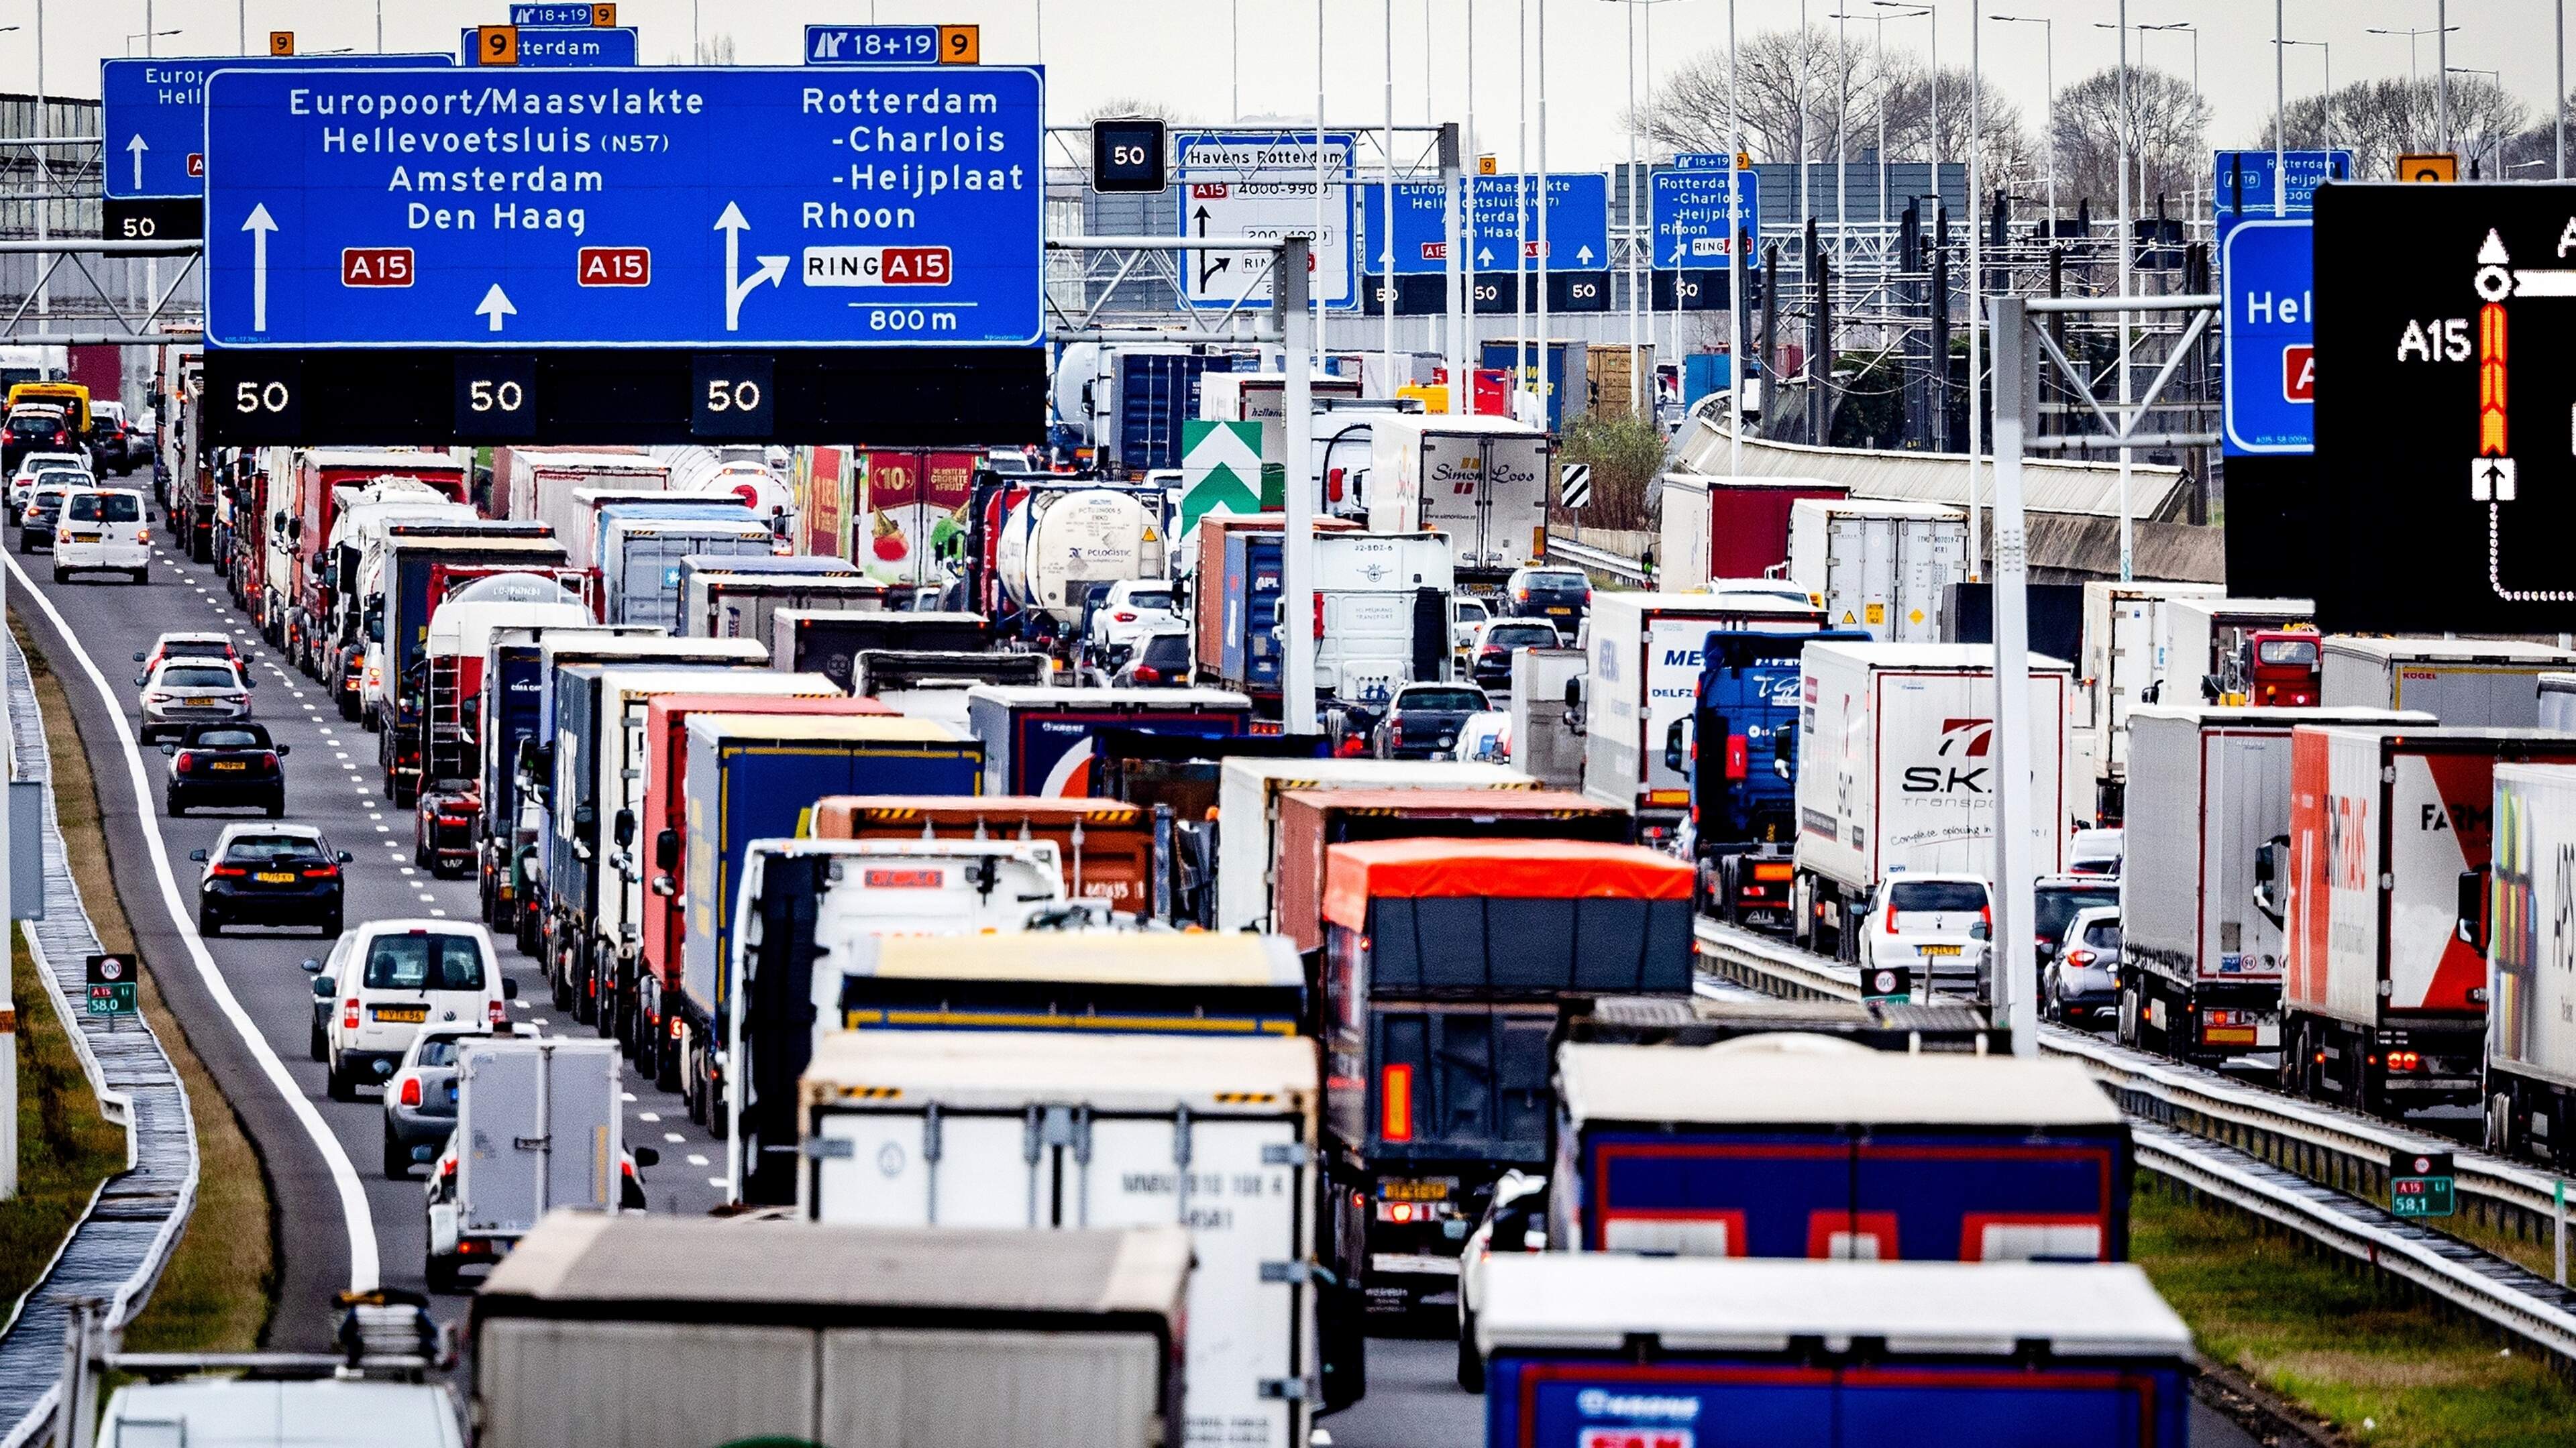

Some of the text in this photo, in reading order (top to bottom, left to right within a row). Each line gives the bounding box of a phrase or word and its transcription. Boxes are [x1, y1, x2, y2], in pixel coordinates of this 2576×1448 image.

[538, 9, 587, 21] 18+19
[598, 9, 609, 21] 9
[276, 36, 288, 50] 9
[489, 34, 507, 56] 9
[854, 34, 931, 55] 18+19
[951, 34, 968, 56] 9
[290, 87, 703, 120] Europoort/Maasvlakte
[803, 87, 997, 114] Rotterdam
[324, 126, 669, 153] Hellevoetsluis (N57)
[833, 125, 1004, 152] -Charlois
[1114, 146, 1144, 165] 50
[1484, 162, 1491, 171] 9
[388, 165, 602, 192] Amsterdam
[833, 164, 1023, 198] -Heijplaat
[409, 203, 584, 237] Den Haag
[803, 202, 915, 229] Rhoon
[123, 217, 155, 237] 50
[1695, 243, 1723, 251] RING
[350, 256, 407, 279] A15
[586, 256, 643, 278] A15
[809, 256, 879, 276] RING
[888, 254, 945, 278] A15
[1475, 286, 1497, 300] 50
[1572, 284, 1597, 298] 50
[870, 309, 957, 331] 800 m
[2397, 318, 2471, 362] A15
[237, 381, 288, 413] 50
[471, 380, 522, 411] 50
[708, 380, 760, 412] 50
